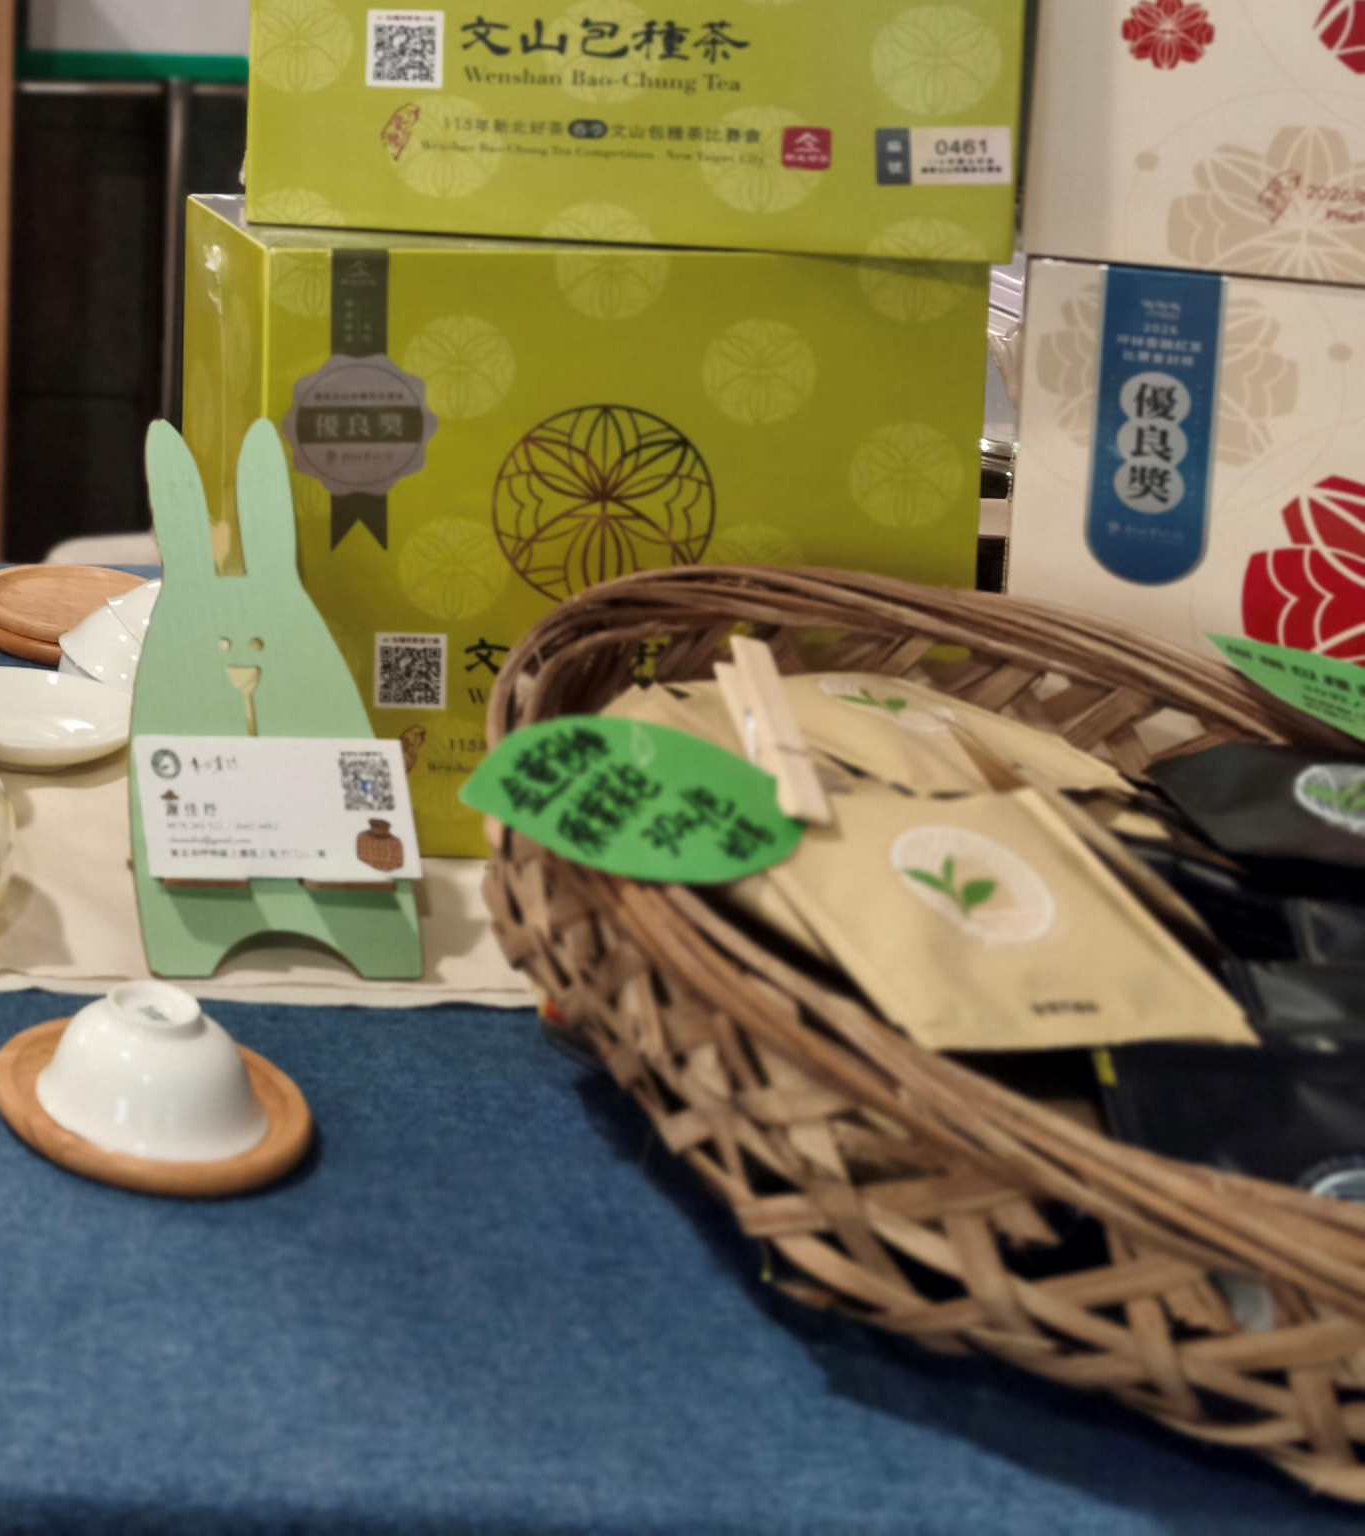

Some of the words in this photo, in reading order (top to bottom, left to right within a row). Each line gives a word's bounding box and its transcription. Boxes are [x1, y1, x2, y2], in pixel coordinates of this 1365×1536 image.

[461, 17, 750, 63] 文山包種茶
[464, 66, 562, 87] Wenshan
[572, 69, 697, 94] Bao-Chung
[703, 74, 741, 91] Tea
[935, 139, 988, 155] 0461
[316, 413, 403, 437] 優良獎
[1128, 383, 1177, 503] 優良獎
